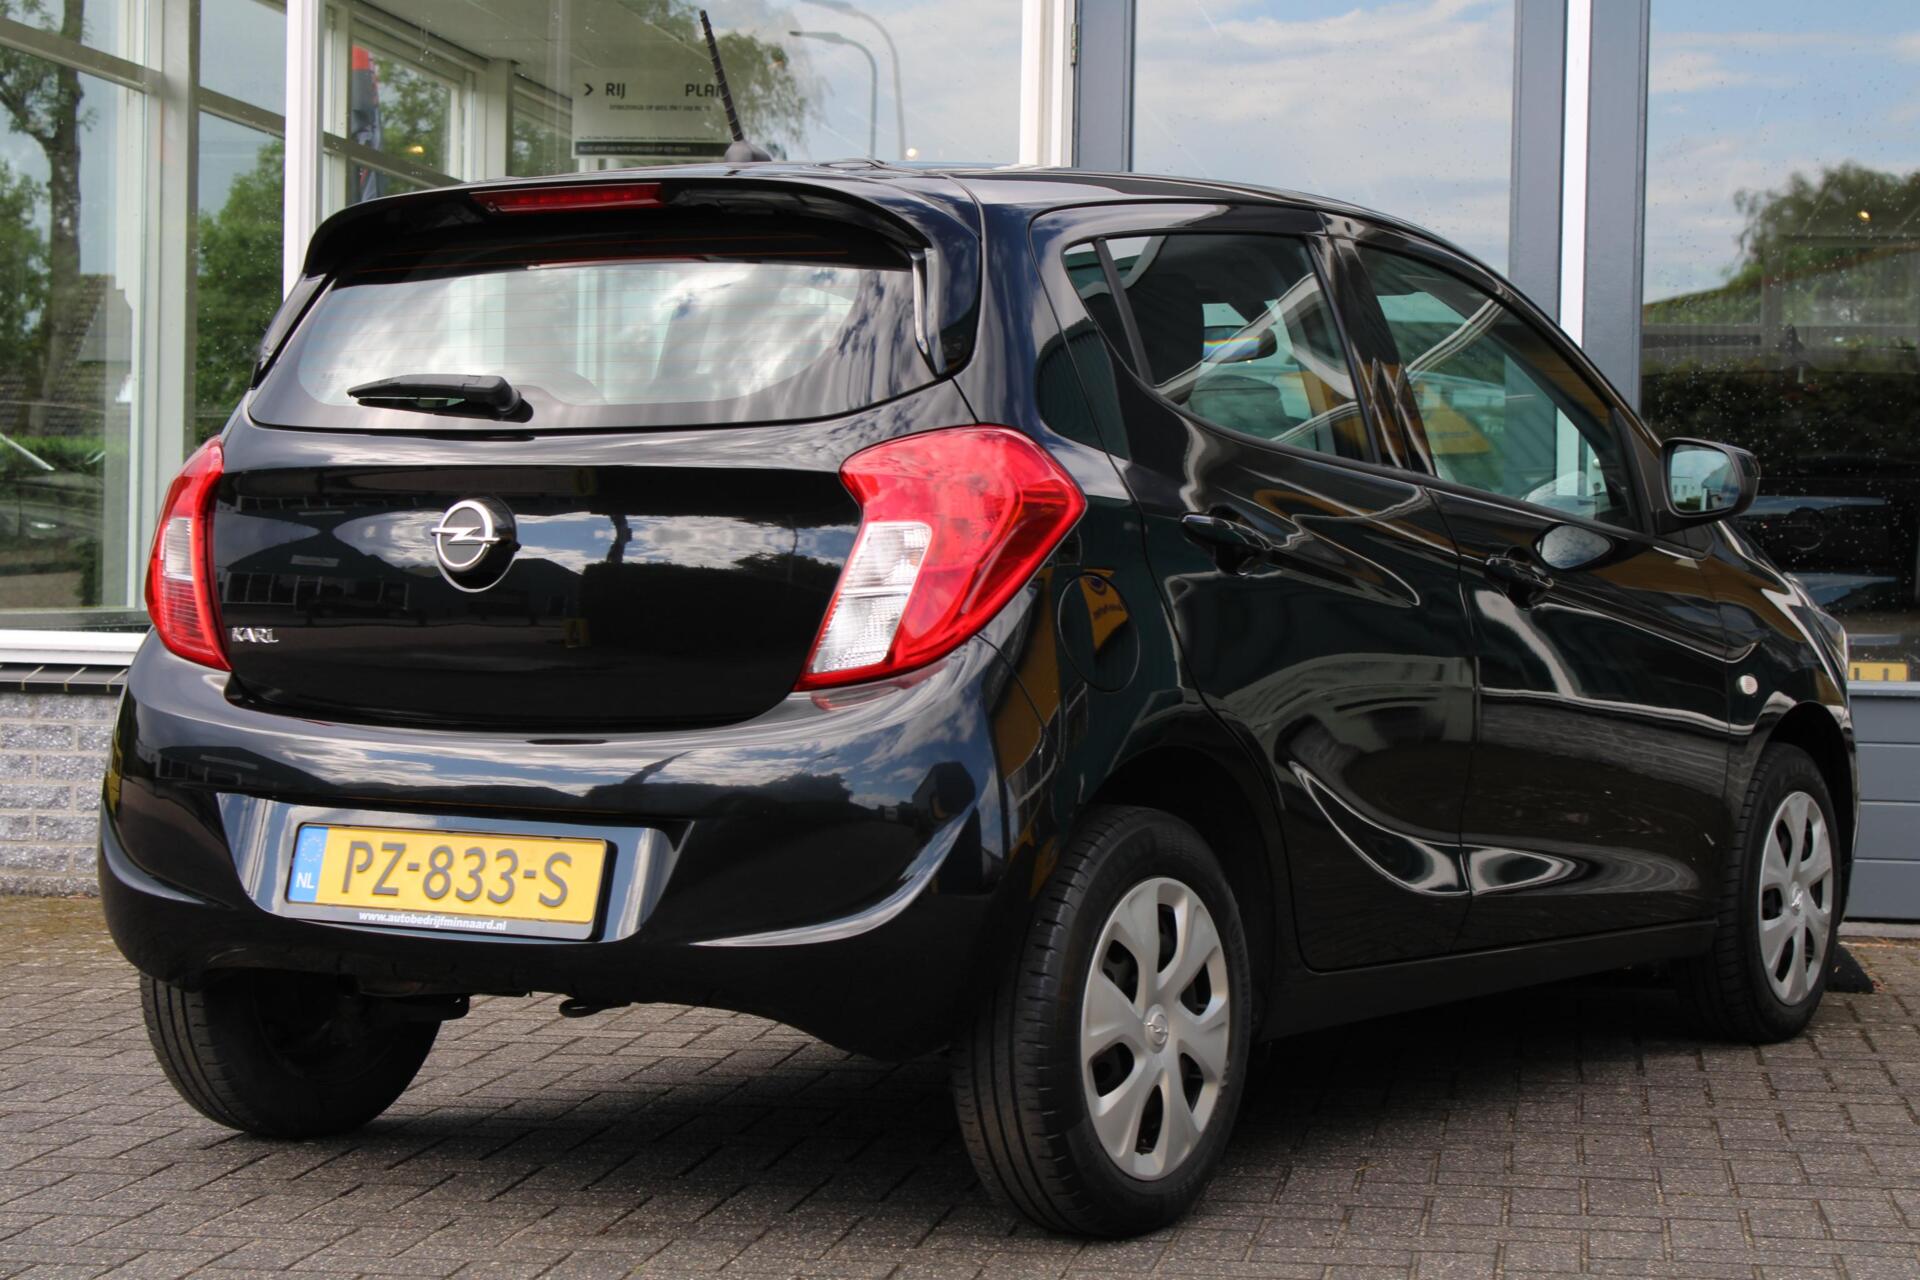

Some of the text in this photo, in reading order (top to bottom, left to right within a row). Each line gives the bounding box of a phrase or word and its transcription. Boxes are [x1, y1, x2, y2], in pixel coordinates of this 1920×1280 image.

[605, 83, 625, 99] RIJ
[231, 627, 279, 643] KARL
[296, 872, 315, 889] NL
[342, 840, 572, 907] PZ-833-S
[358, 911, 507, 932] www.autobedrijfminnaard.nl
